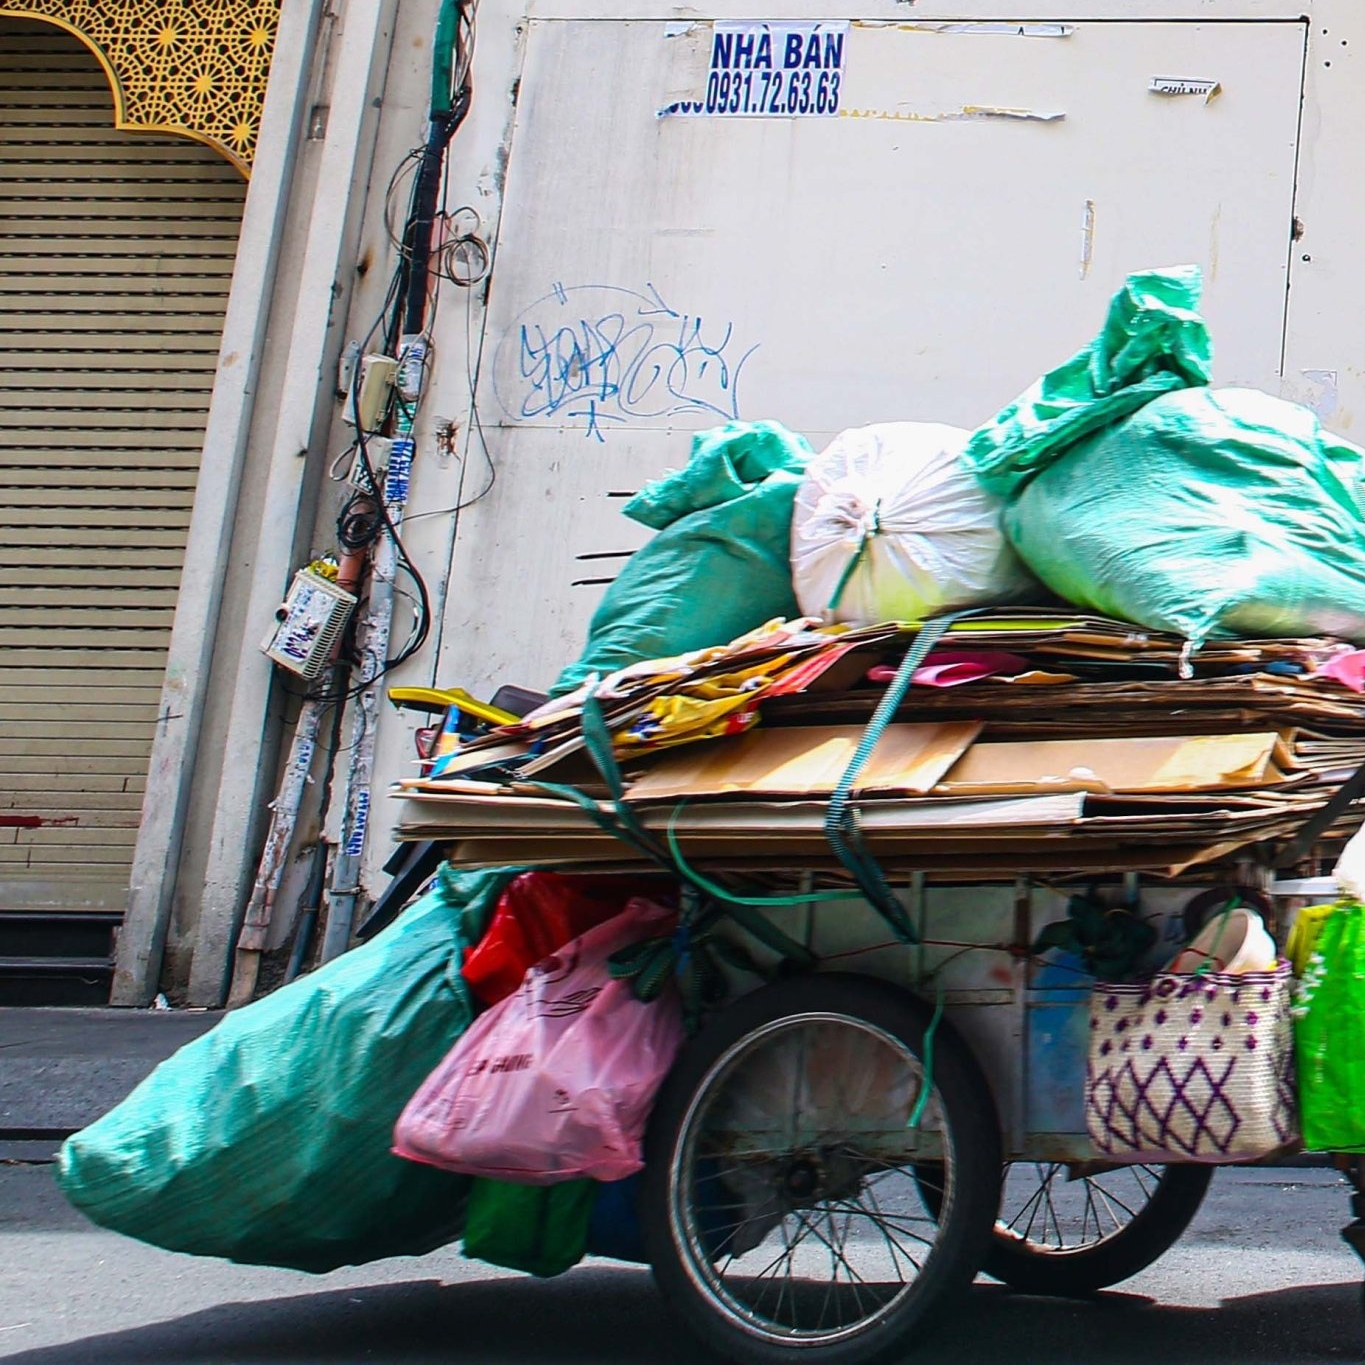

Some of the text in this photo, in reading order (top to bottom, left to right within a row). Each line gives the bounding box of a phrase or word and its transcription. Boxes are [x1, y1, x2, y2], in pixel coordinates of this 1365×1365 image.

[711, 23, 845, 69] NHÀ BÁN
[705, 71, 841, 114] 0931.72.63.63
